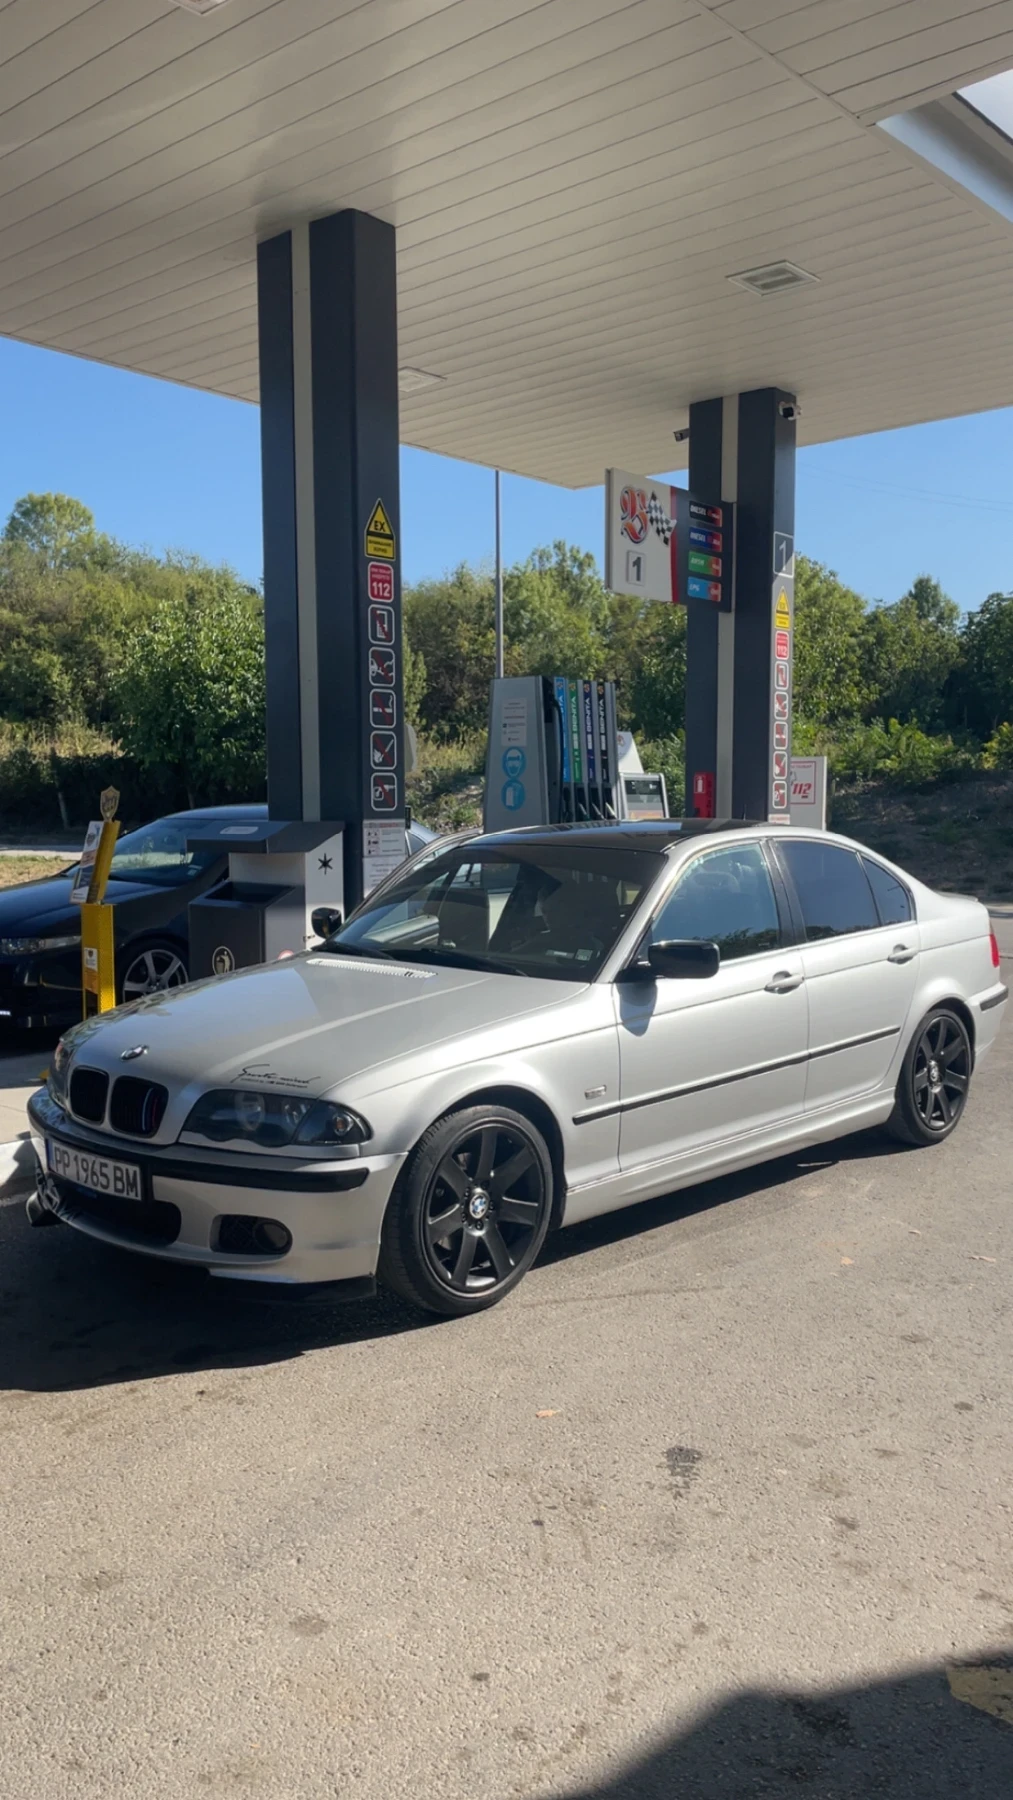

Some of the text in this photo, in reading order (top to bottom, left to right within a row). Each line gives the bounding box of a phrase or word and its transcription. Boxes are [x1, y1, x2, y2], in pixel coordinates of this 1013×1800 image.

[690, 504, 707, 516] DIESEL
[374, 520, 386, 533] EX
[689, 531, 706, 543] DIESEL
[779, 540, 787, 571] 1
[632, 556, 642, 581] 1
[372, 581, 391, 598] 112
[792, 782, 812, 795] 112
[73, 1154, 110, 1190] 1965
[113, 1165, 139, 1198] BM
